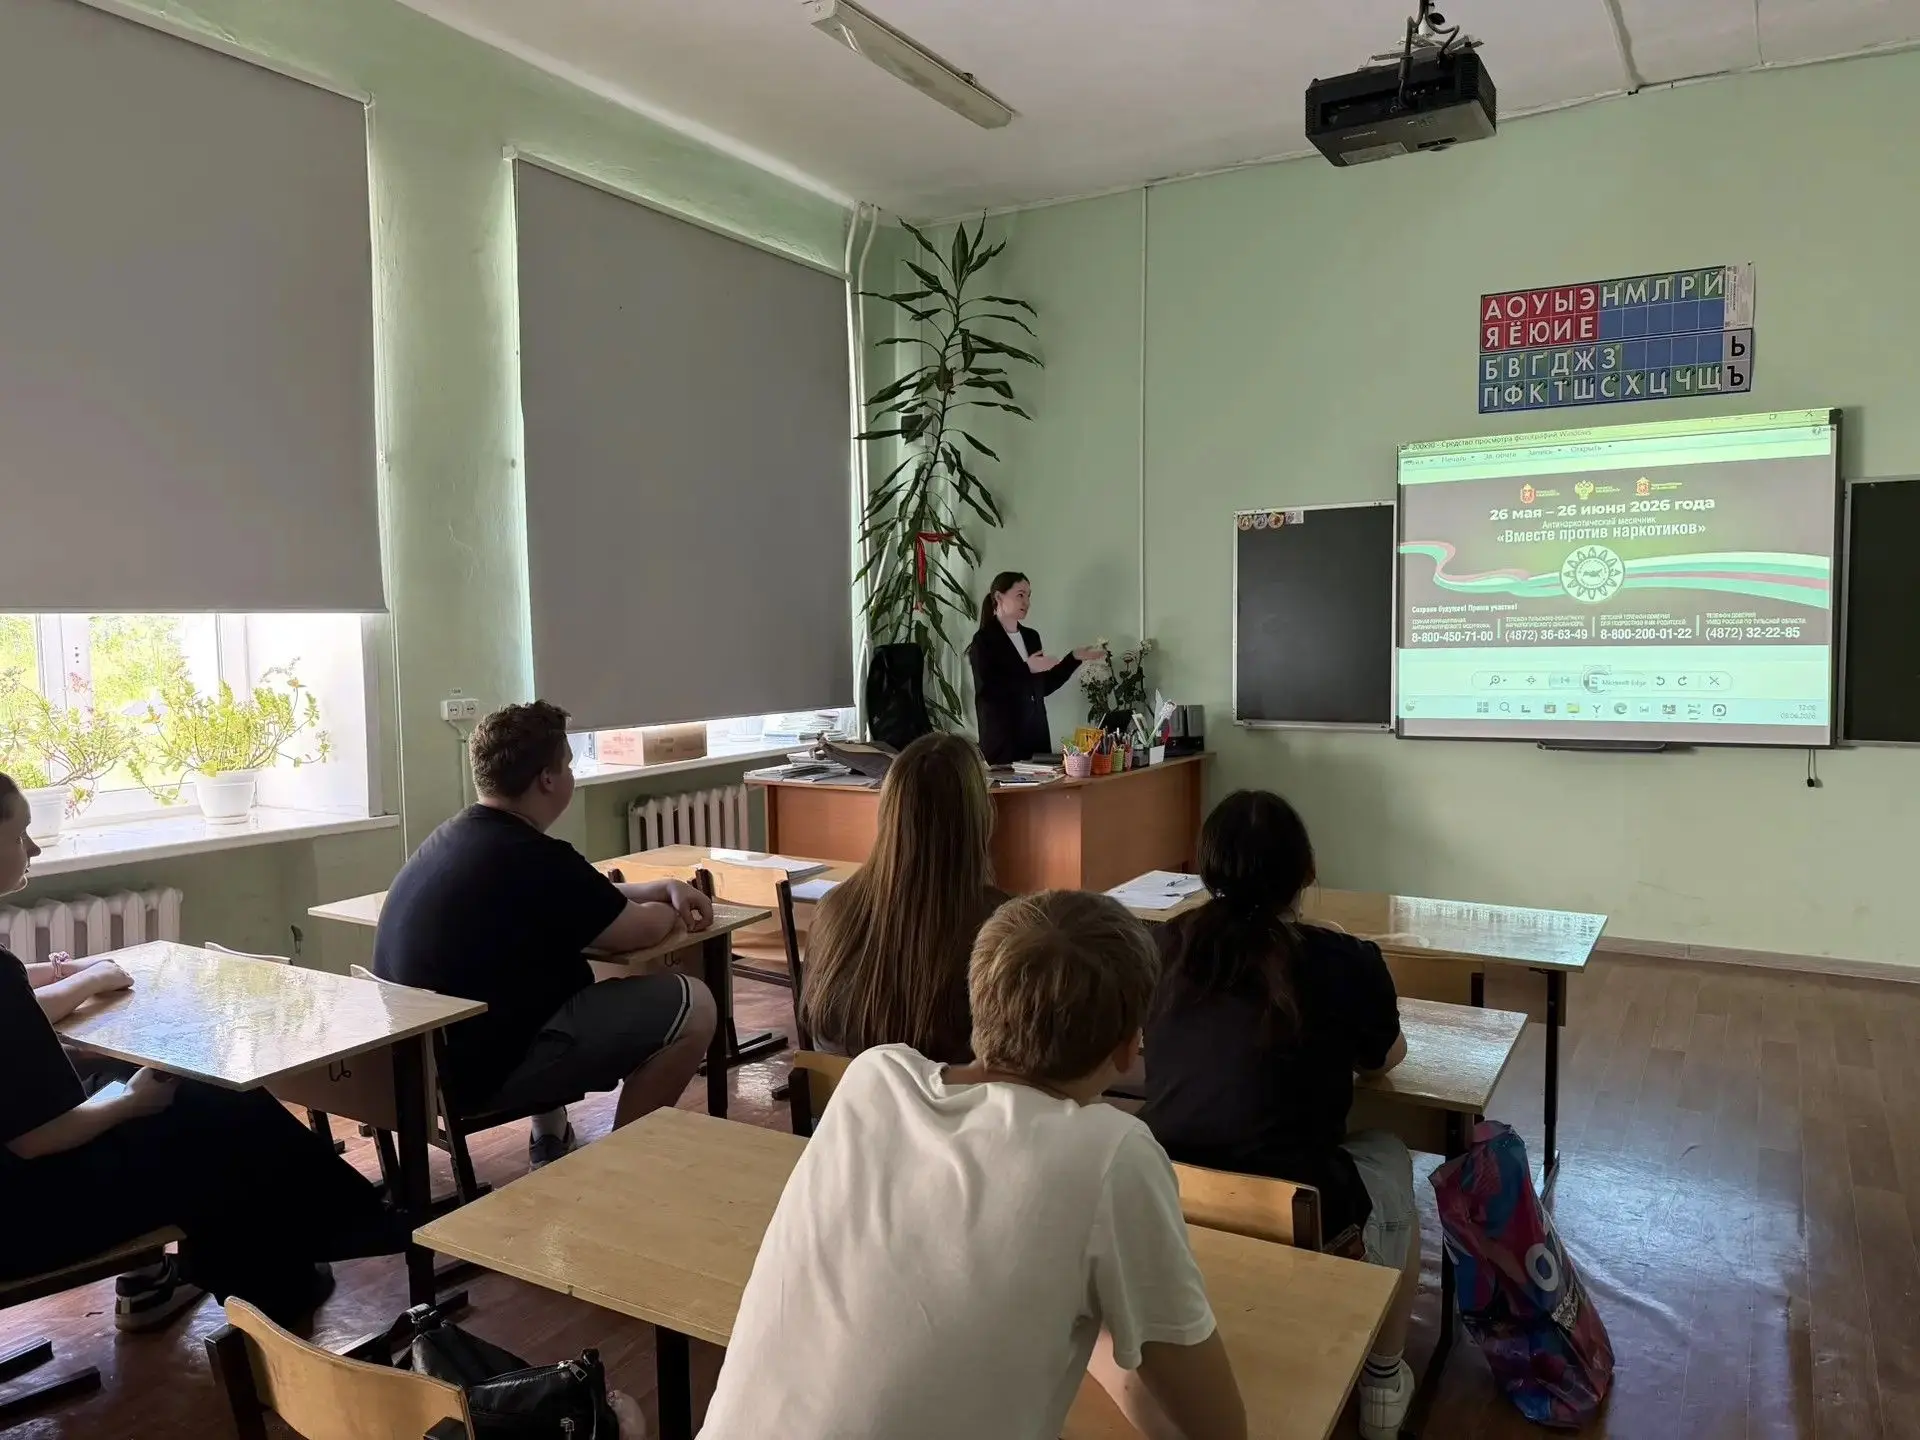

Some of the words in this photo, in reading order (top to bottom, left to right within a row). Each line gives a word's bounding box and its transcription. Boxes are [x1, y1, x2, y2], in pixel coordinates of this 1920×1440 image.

[1490, 508, 1509, 521] 26
[1512, 507, 1542, 520] мая
[1557, 504, 1577, 517] 26
[1580, 503, 1626, 516] июня
[1629, 499, 1671, 513] 2026
[1674, 498, 1715, 511] года
[1497, 529, 1556, 543] «Вместе
[1559, 527, 1608, 542] против
[1612, 522, 1706, 540] наркотиков»
[1411, 631, 1494, 642] 8-800-450-71-00
[1505, 630, 1538, 642] (4872)
[1540, 628, 1588, 640] 36-63-49
[1600, 628, 1692, 639] 8-800-200-01-22
[1705, 627, 1743, 640] (4872)
[1746, 627, 1800, 638] 32-22-85
